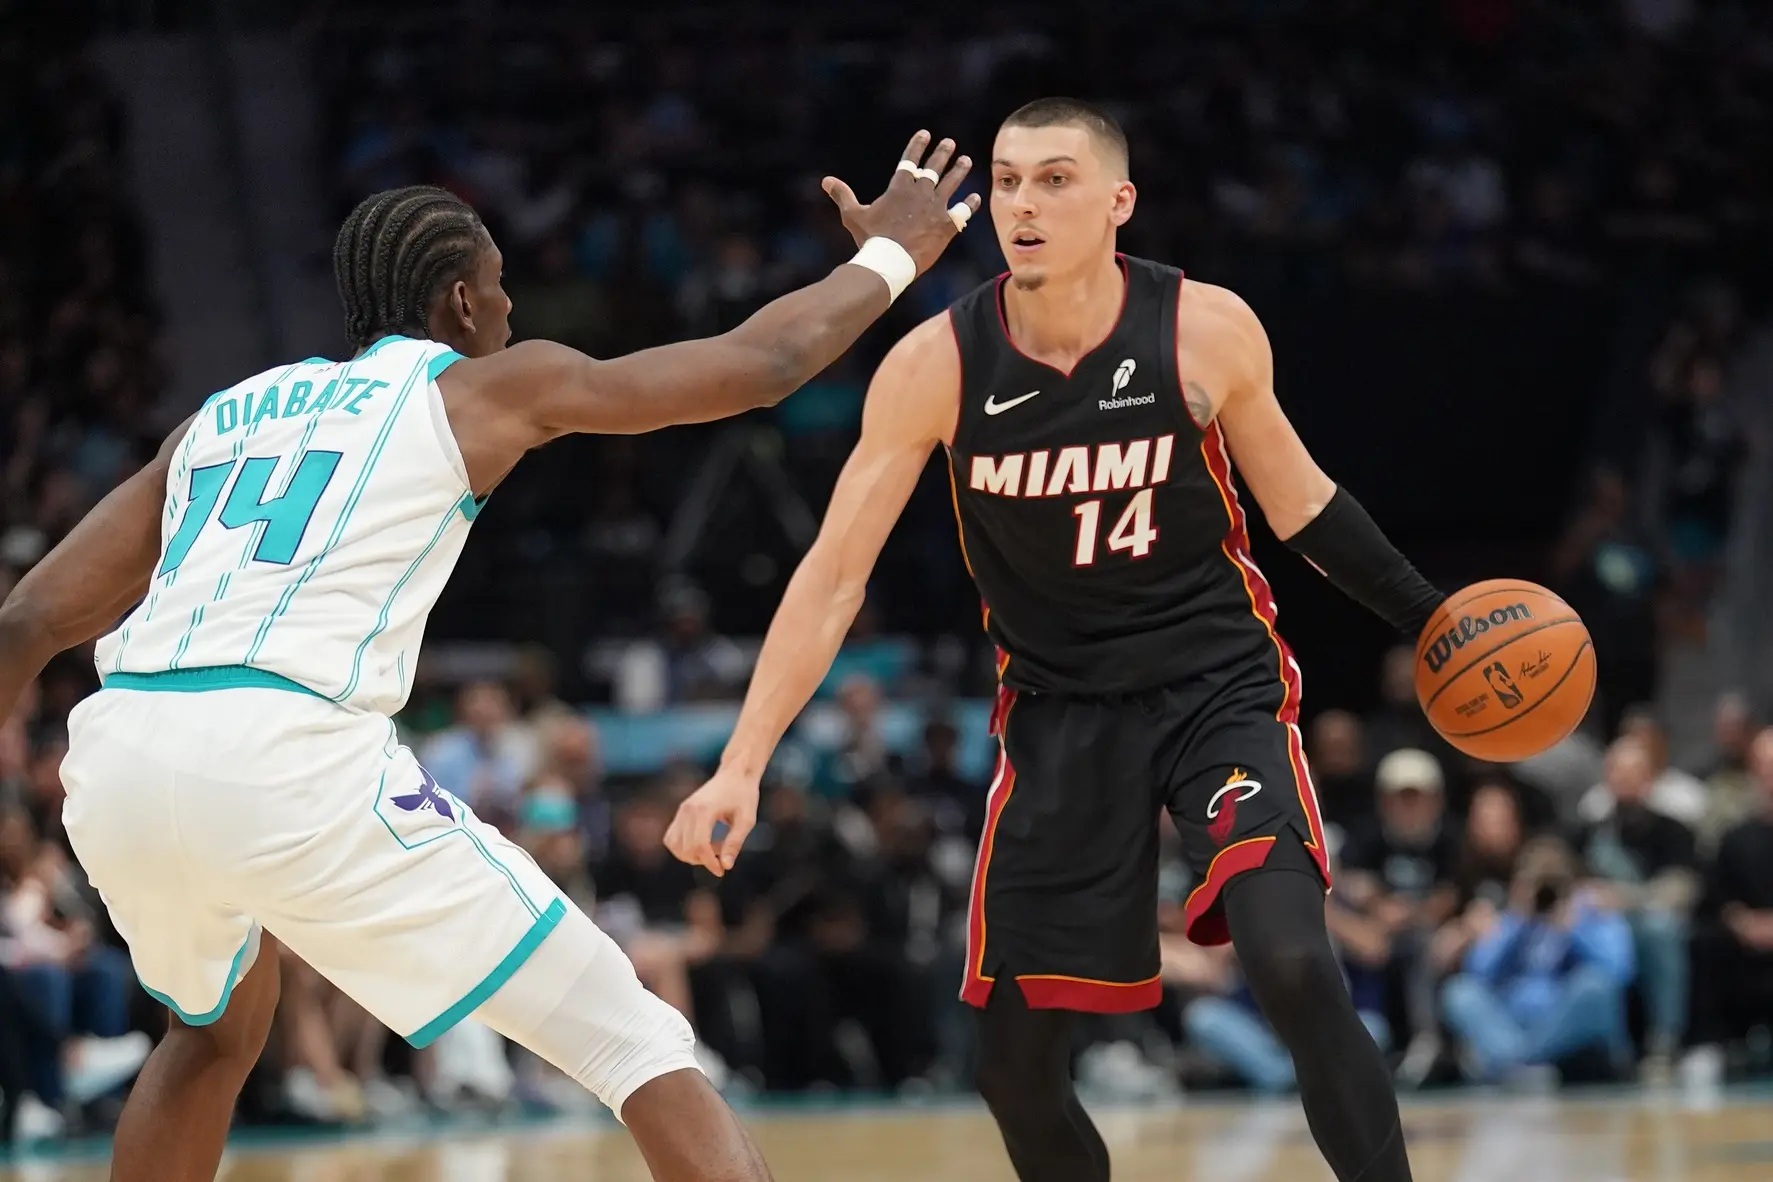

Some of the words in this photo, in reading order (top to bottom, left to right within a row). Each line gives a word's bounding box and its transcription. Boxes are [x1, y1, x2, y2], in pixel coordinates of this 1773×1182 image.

[216, 378, 390, 435] DIABATE
[1099, 392, 1155, 410] Robinhood
[969, 433, 1175, 498] MIAMI
[1073, 487, 1159, 567] 14
[1424, 602, 1535, 674] Wilson
